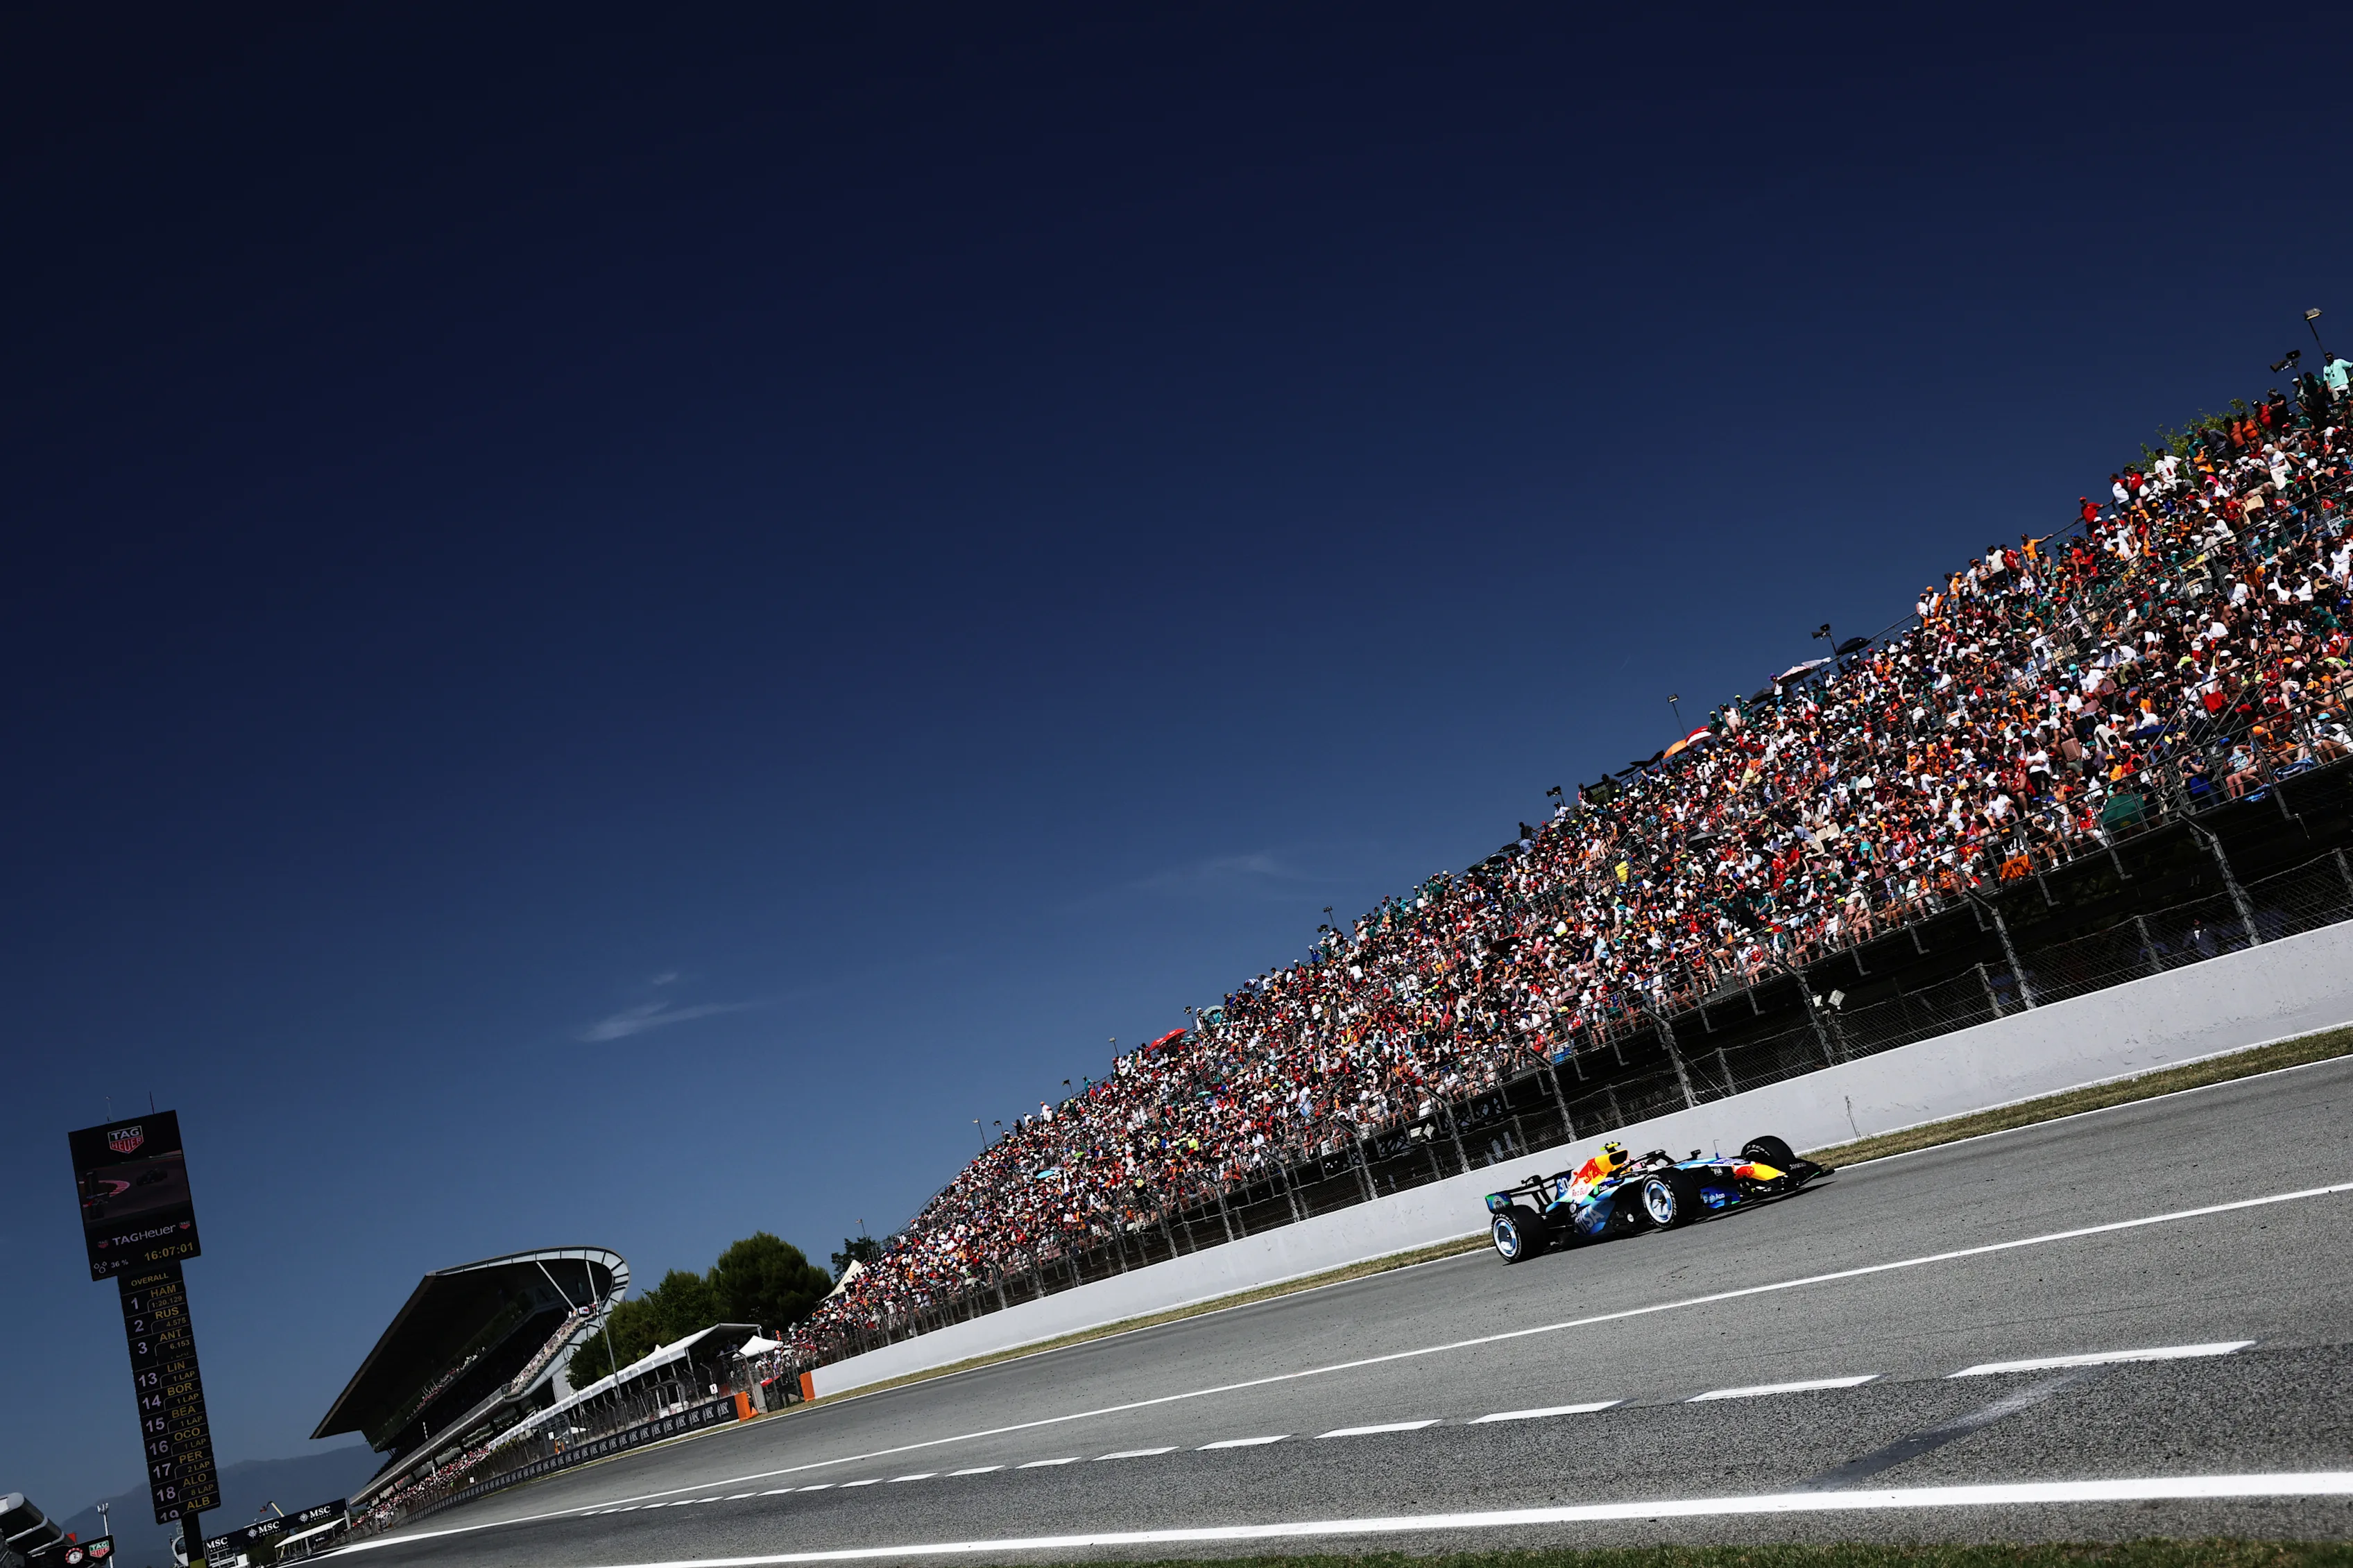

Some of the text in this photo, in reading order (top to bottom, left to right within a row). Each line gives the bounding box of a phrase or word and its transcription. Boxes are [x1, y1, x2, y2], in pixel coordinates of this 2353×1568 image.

[111, 1128, 139, 1140] TAG
[112, 1137, 142, 1151] HEUER
[1557, 1177, 1568, 1193] 30
[1574, 1206, 1605, 1234] VISA
[144, 1242, 194, 1261] 16:07:01
[130, 1273, 169, 1286] OVERALL
[151, 1284, 176, 1298] HAM
[131, 1297, 138, 1310] 1
[152, 1295, 182, 1308] 1:20.129
[155, 1307, 179, 1320] RUS
[134, 1319, 144, 1333] 2
[160, 1329, 182, 1342] ANT
[137, 1341, 148, 1354] 3
[169, 1340, 190, 1350] 6.153
[167, 1361, 185, 1373] LIN
[139, 1372, 157, 1387] 13
[179, 1370, 195, 1380] LAP
[167, 1382, 193, 1396] BOR
[142, 1394, 162, 1409] 14
[183, 1393, 199, 1403] LAP
[171, 1405, 196, 1418] BEA
[146, 1417, 165, 1432] 15
[187, 1415, 203, 1425] LAP
[174, 1427, 200, 1441] OCO
[149, 1440, 169, 1455] 16
[190, 1438, 206, 1448] LAP
[178, 1450, 203, 1464] PER
[153, 1463, 171, 1479] 17
[194, 1461, 210, 1470] LAP
[183, 1473, 206, 1488] ALO
[156, 1486, 176, 1501] 18
[198, 1484, 214, 1494] LAP
[187, 1496, 210, 1510] ALB
[309, 1506, 331, 1519] MSC
[258, 1521, 280, 1533] MSC
[90, 1540, 108, 1549] TAG
[206, 1537, 228, 1549] MSC
